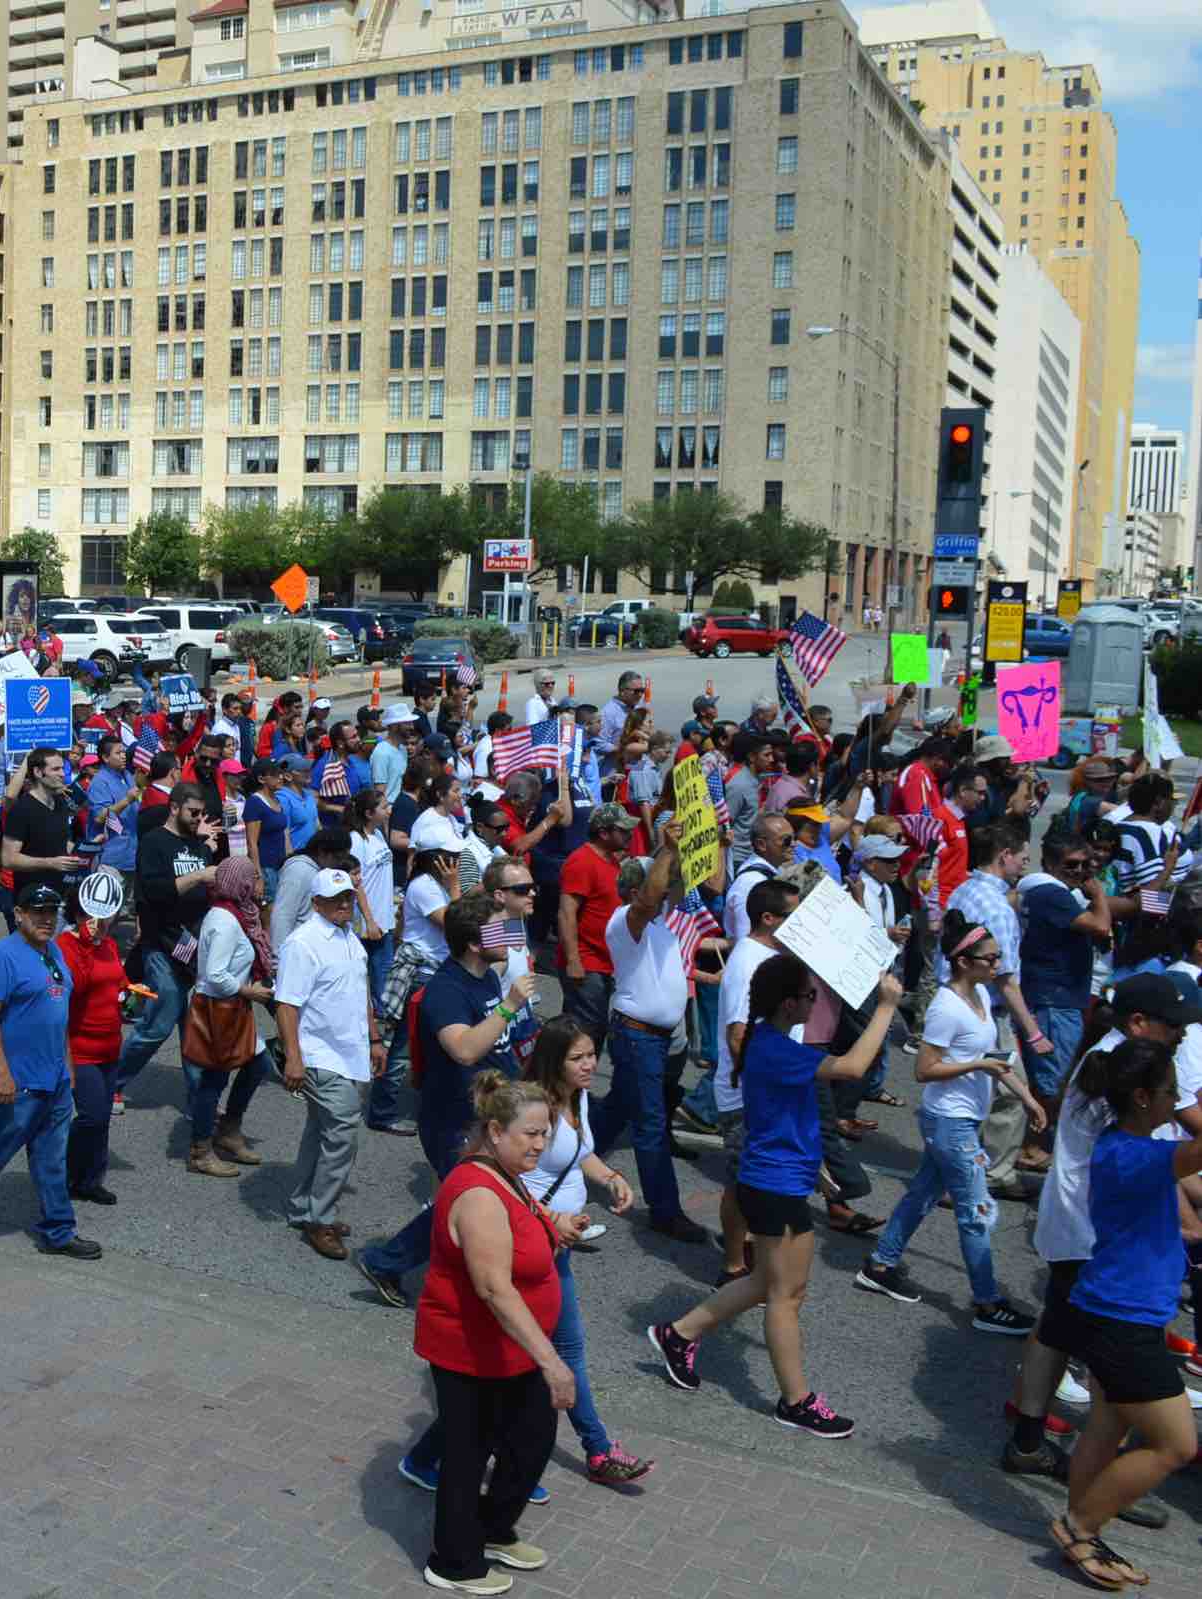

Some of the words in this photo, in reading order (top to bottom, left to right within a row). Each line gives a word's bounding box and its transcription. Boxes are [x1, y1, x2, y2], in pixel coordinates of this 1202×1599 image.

[936, 536, 975, 548] Griffin
[488, 559, 527, 570] Parking
[81, 874, 121, 906] NOW
